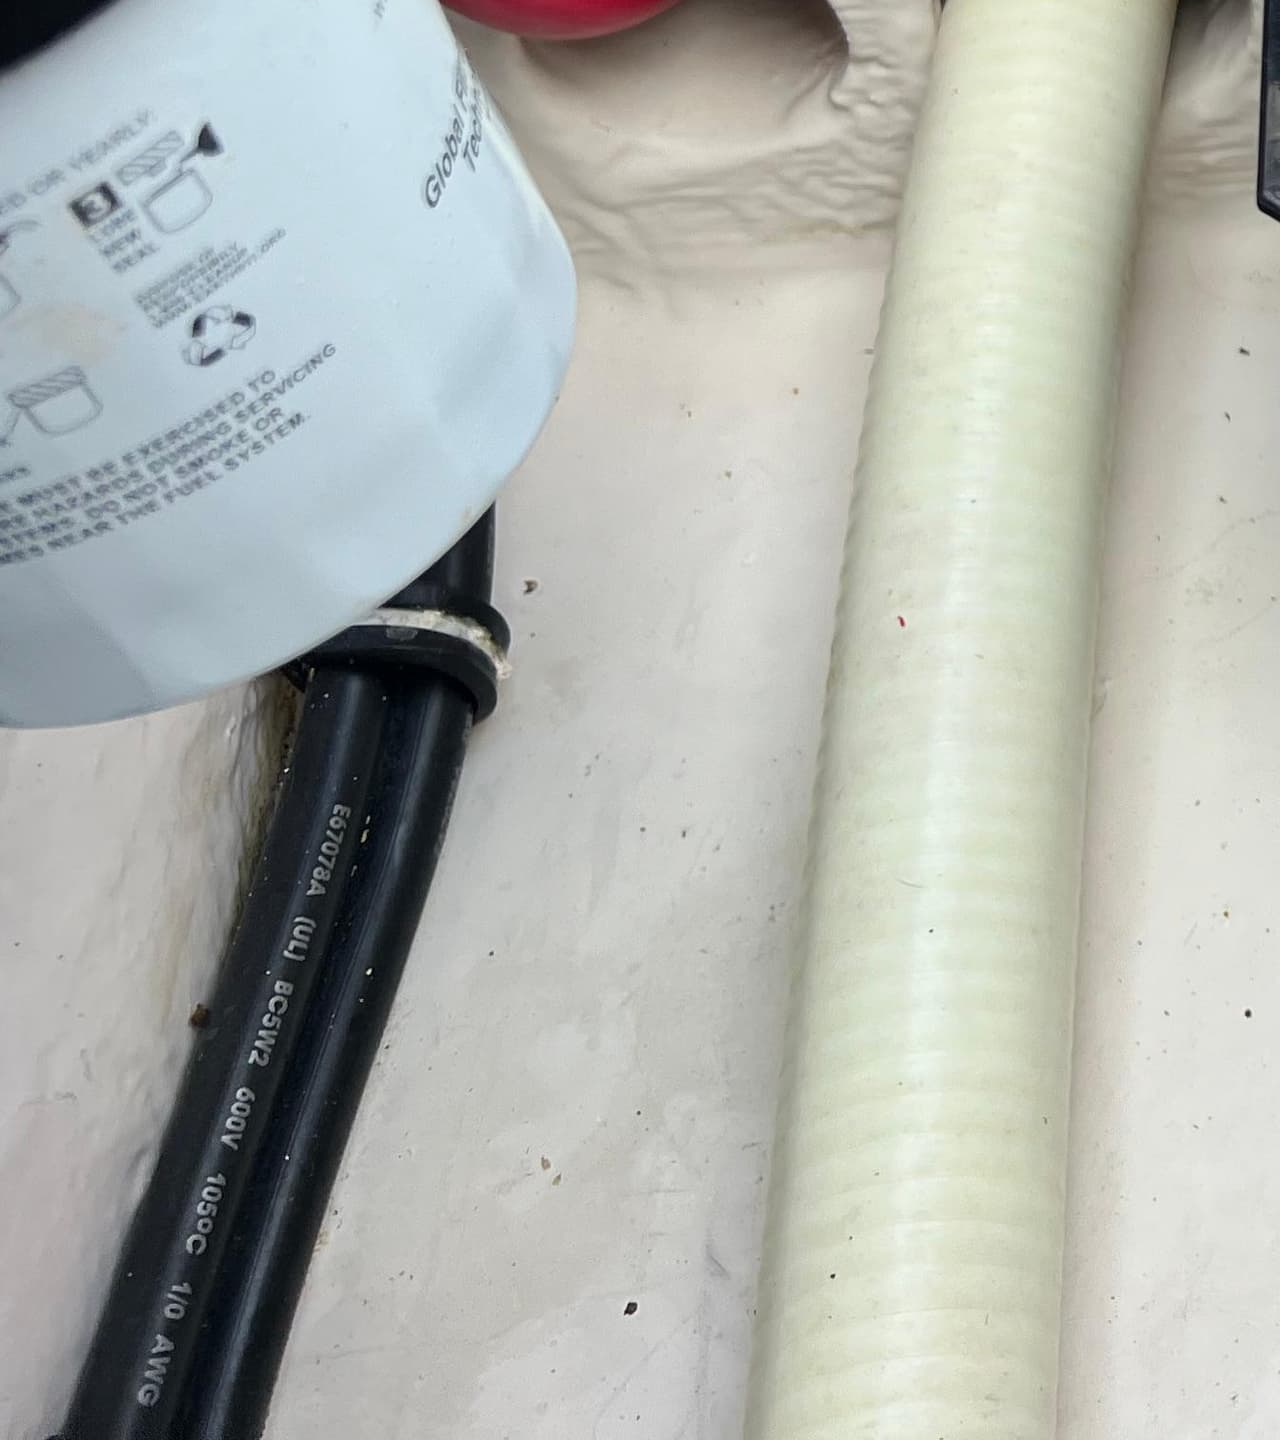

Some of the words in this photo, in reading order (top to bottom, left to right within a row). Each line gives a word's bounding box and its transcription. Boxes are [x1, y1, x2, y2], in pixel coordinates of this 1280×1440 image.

[235, 344, 337, 422] SERVICING
[248, 370, 276, 393] TO
[254, 408, 285, 433] OR
[306, 803, 351, 898] E67078A
[282, 914, 316, 962] (UL)
[247, 979, 294, 1068] BC5W2
[219, 1085, 256, 1151] 600V
[163, 1280, 193, 1321] 1/0
[138, 1333, 175, 1409] AWG
